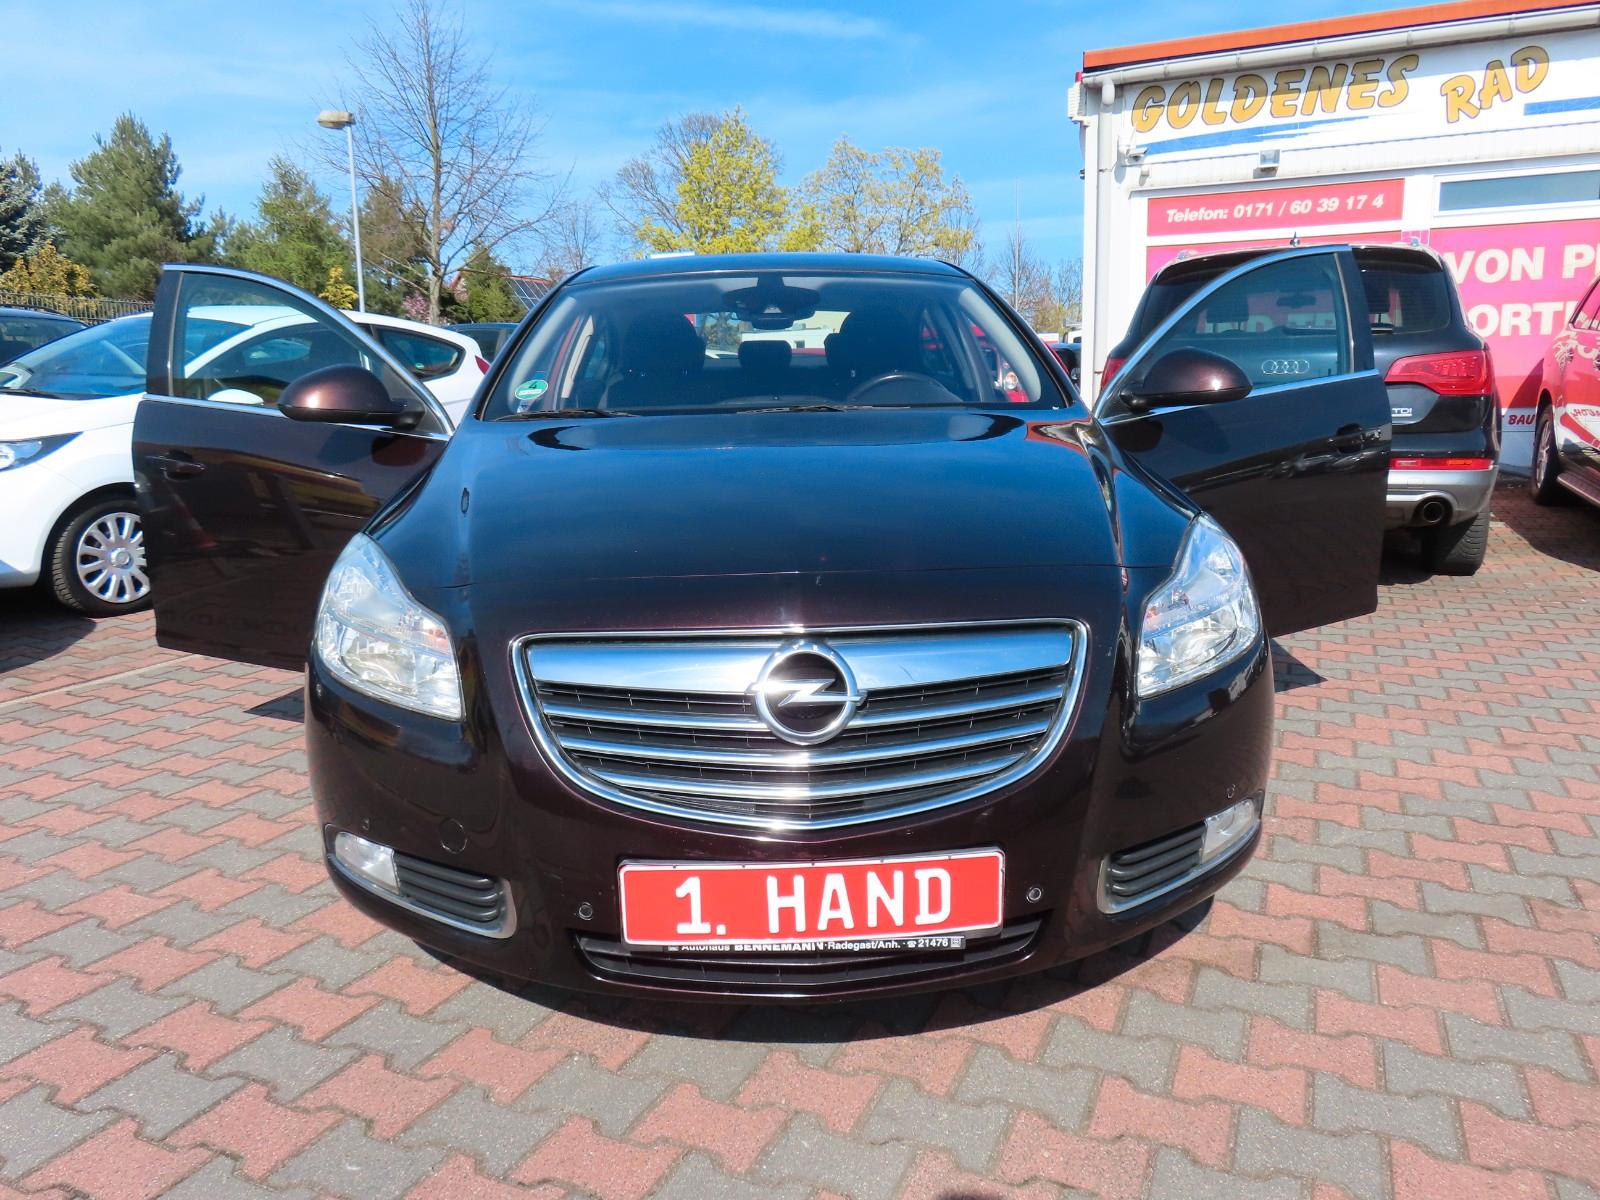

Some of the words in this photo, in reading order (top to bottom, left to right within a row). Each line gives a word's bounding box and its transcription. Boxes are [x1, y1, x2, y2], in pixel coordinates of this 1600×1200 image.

[1131, 54, 1419, 133] GOLDENES
[1440, 45, 1550, 123] RAD
[1166, 206, 1229, 223] Telefon:
[1233, 202, 1273, 219] 0171
[1289, 199, 1312, 215] 60
[1316, 197, 1339, 213] 39
[1346, 195, 1368, 211] 17
[1372, 193, 1385, 209] 4
[1442, 247, 1545, 284] VON
[1508, 414, 1536, 425] BAU
[675, 876, 727, 936] 1.
[766, 867, 951, 934] HAND
[828, 939, 901, 952] Radegast/Anh.
[917, 936, 949, 948] 21476
